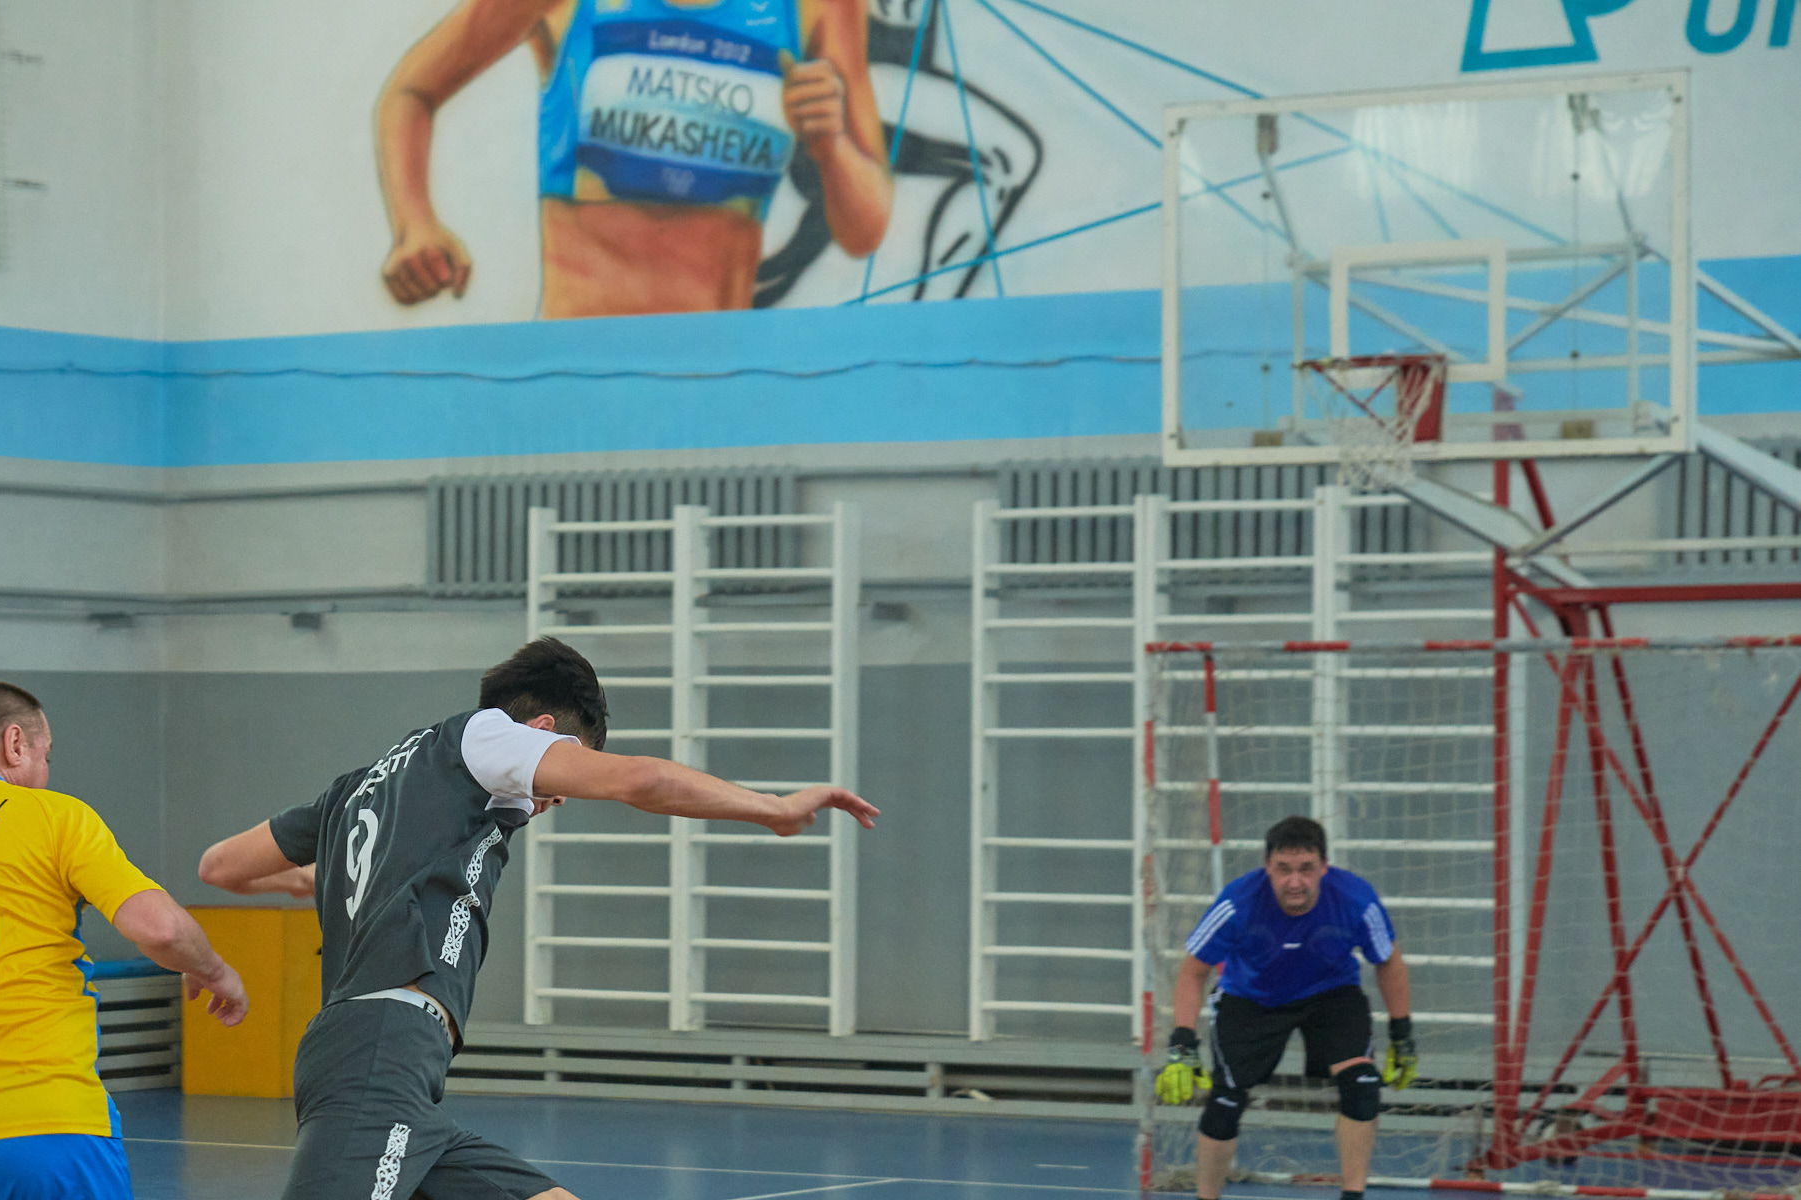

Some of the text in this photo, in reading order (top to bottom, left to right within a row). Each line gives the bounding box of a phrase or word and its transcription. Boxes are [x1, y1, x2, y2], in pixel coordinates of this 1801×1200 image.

[627, 66, 754, 117] MATSKO
[590, 107, 773, 168] MUKASHEVA
[345, 808, 379, 920] 9
